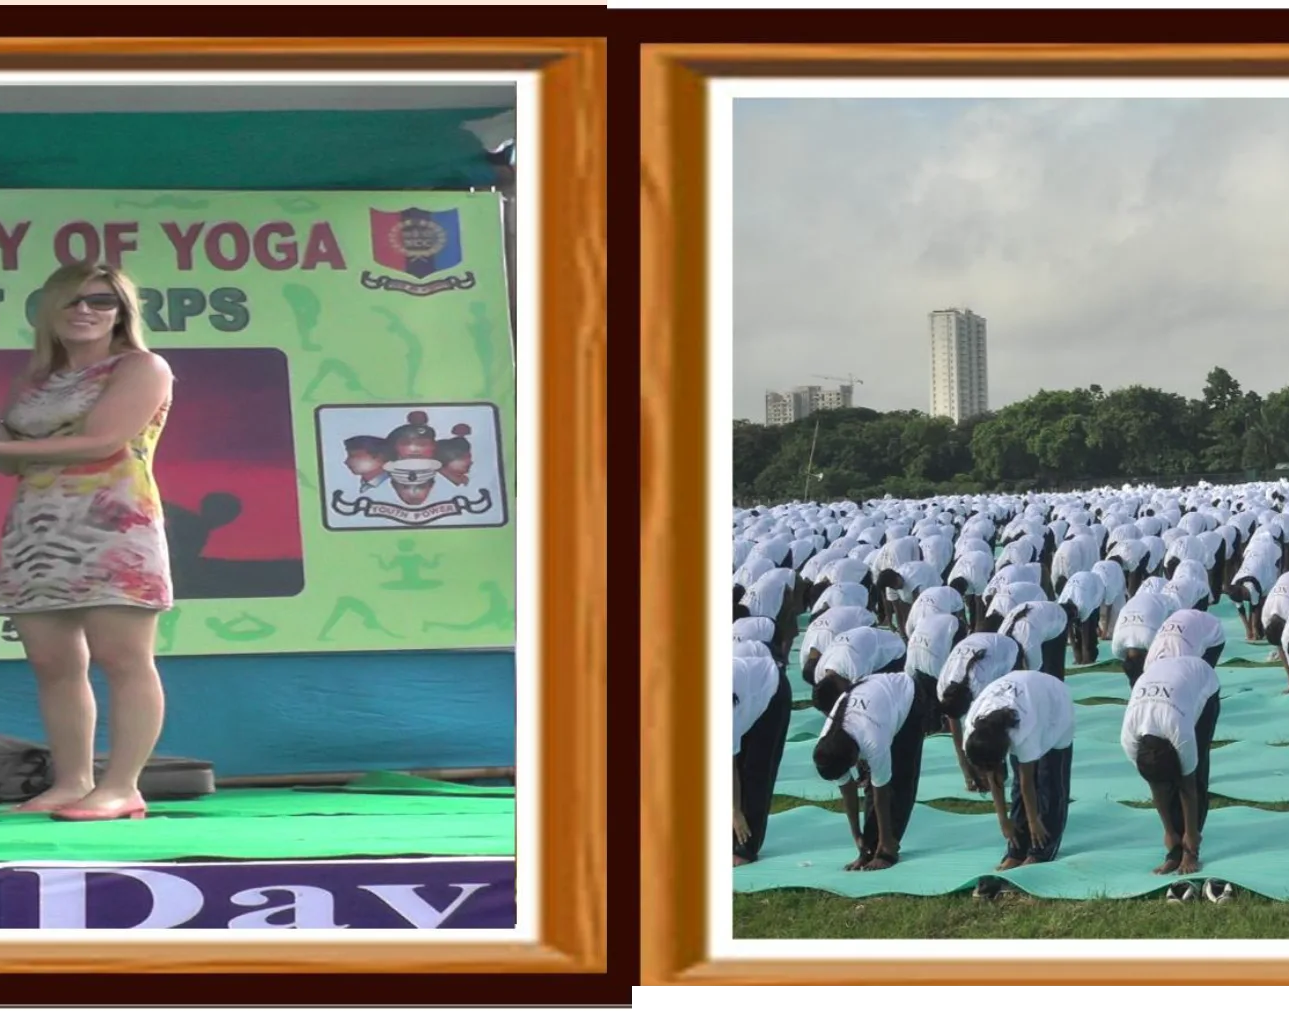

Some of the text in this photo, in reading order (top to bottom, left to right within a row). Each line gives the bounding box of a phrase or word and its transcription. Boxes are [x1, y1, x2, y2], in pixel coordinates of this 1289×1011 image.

[53, 220, 139, 270] OF
[160, 219, 347, 272] YOGA
[25, 287, 251, 333] RPS
[372, 505, 454, 520] YOUTH POWER
[1134, 686, 1174, 699] NCC
